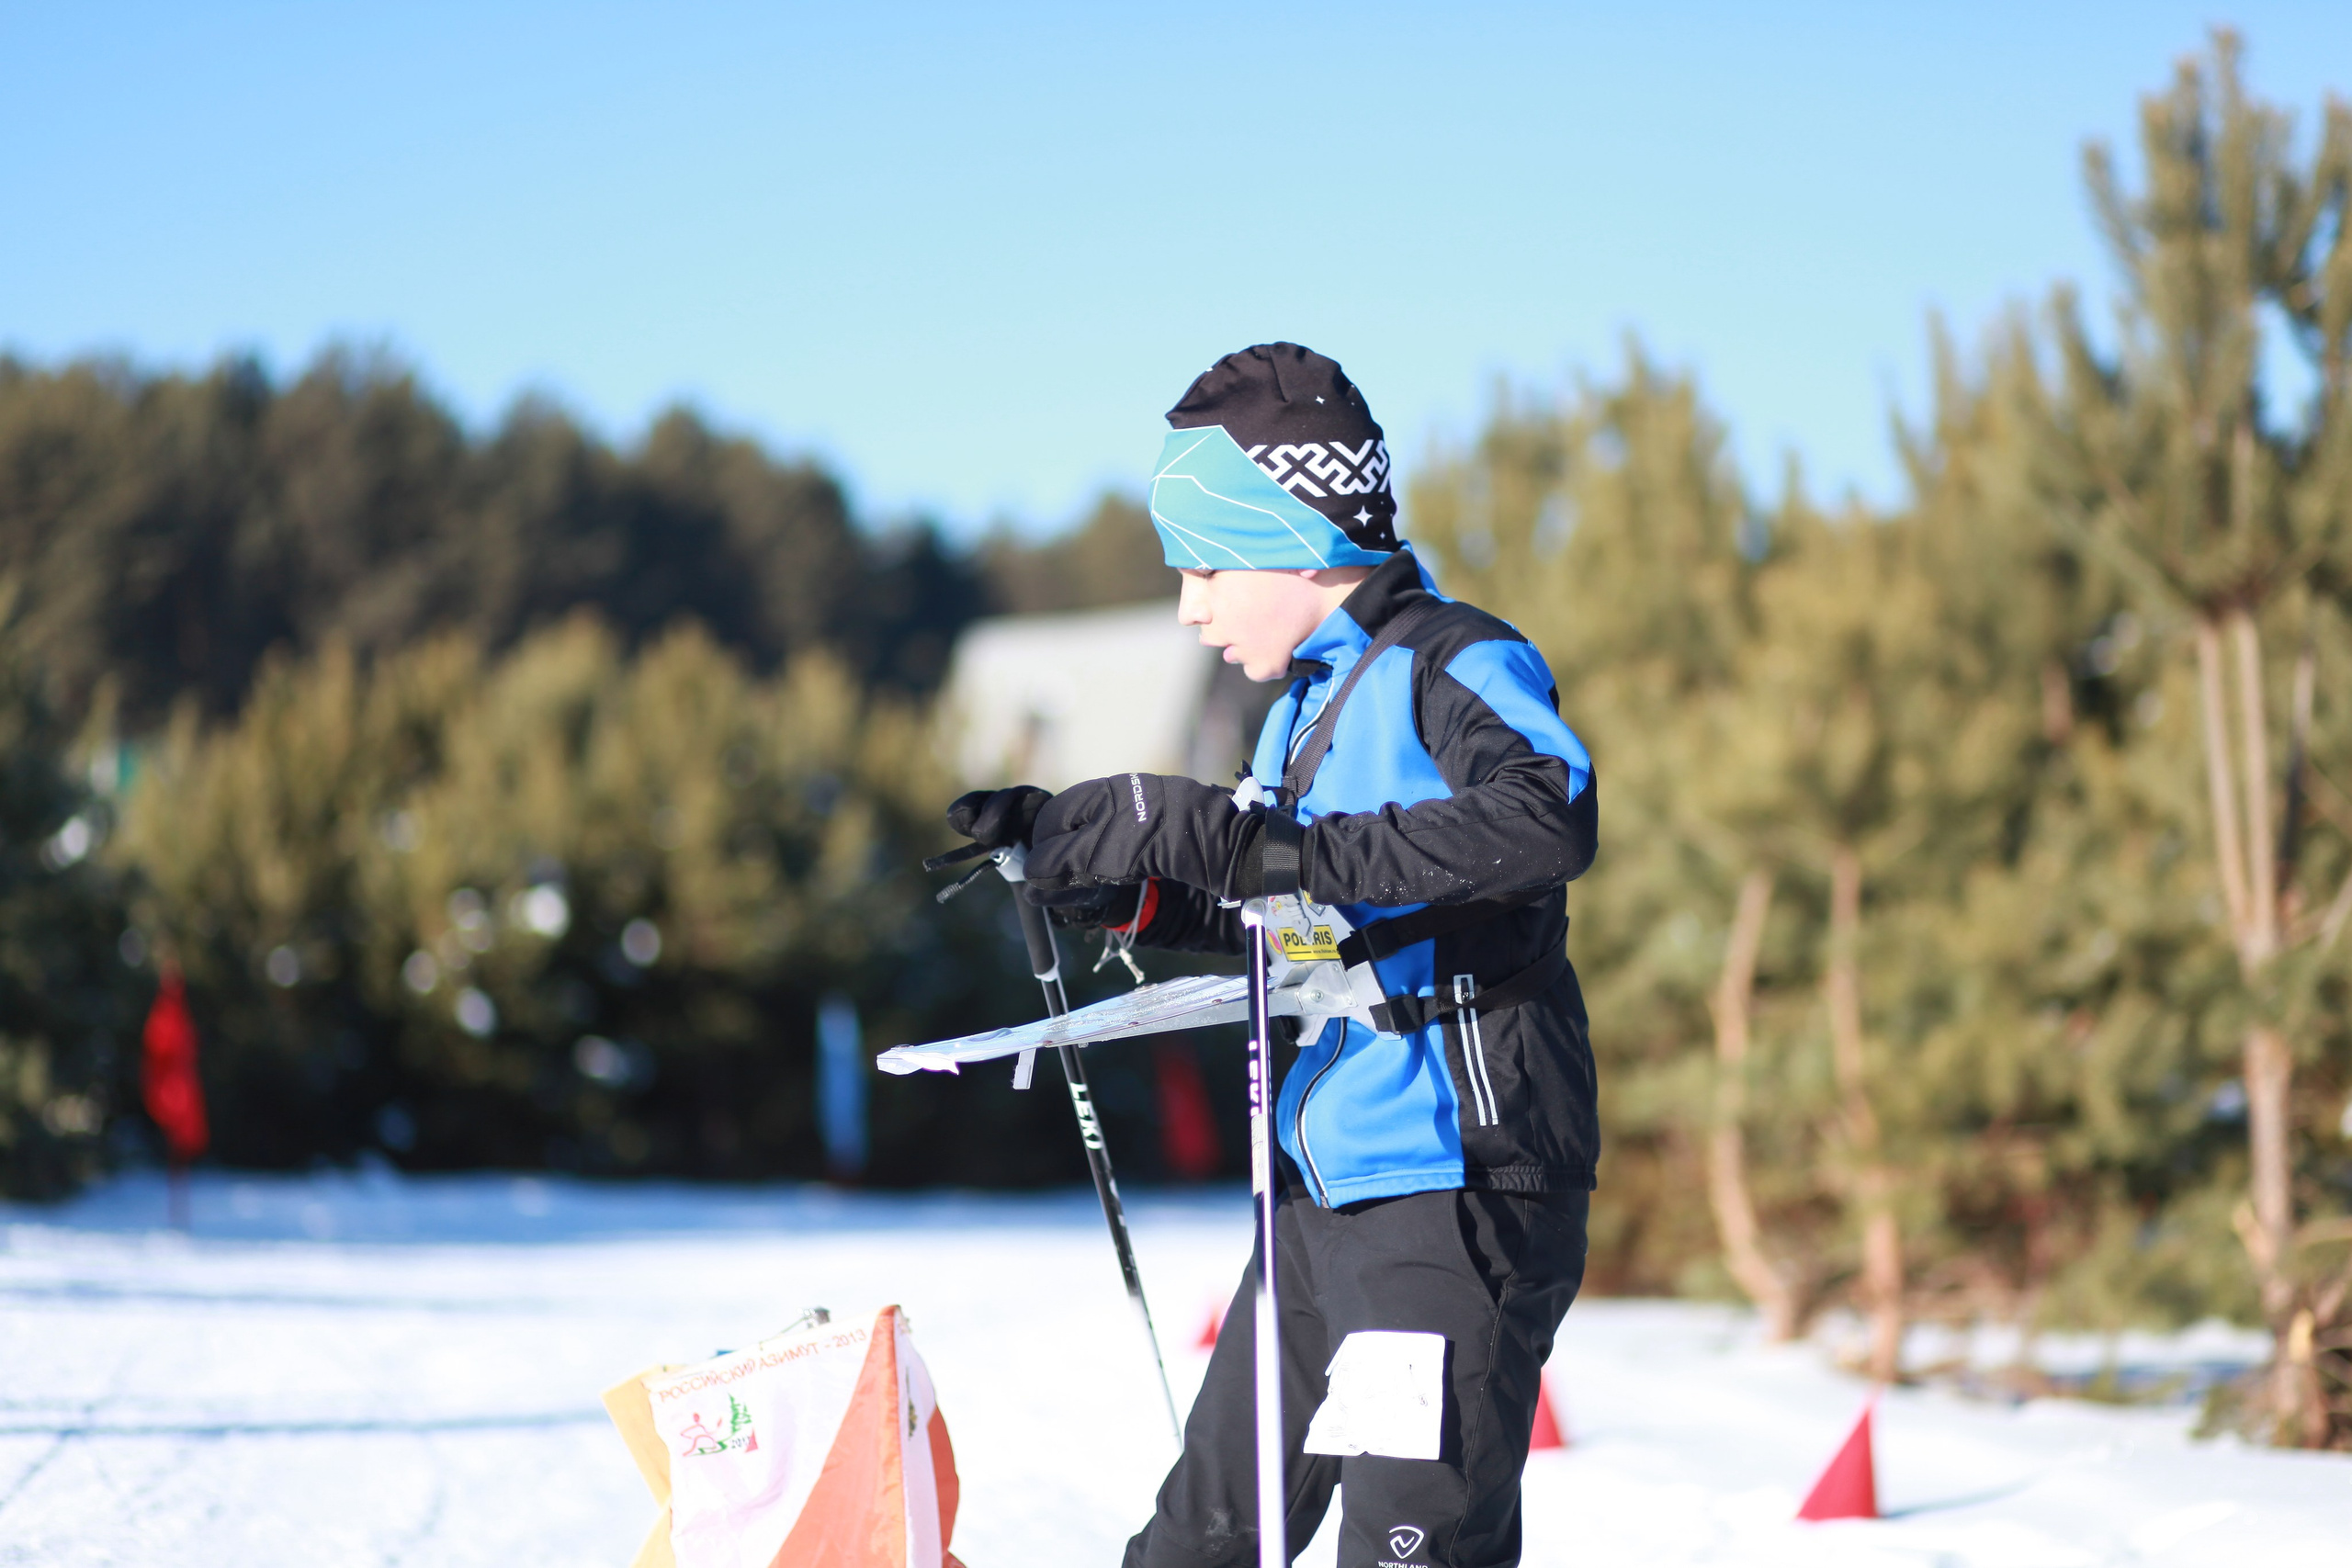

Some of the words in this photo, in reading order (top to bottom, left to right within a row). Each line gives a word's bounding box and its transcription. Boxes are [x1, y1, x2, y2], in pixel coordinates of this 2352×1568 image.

[1283, 931, 1332, 947] POLRIS
[1069, 1081, 1103, 1150] LEKI
[659, 1358, 756, 1403] РОССИЙСКИЙ
[758, 1342, 820, 1371] АЗИМУТ
[831, 1328, 866, 1348] 2013
